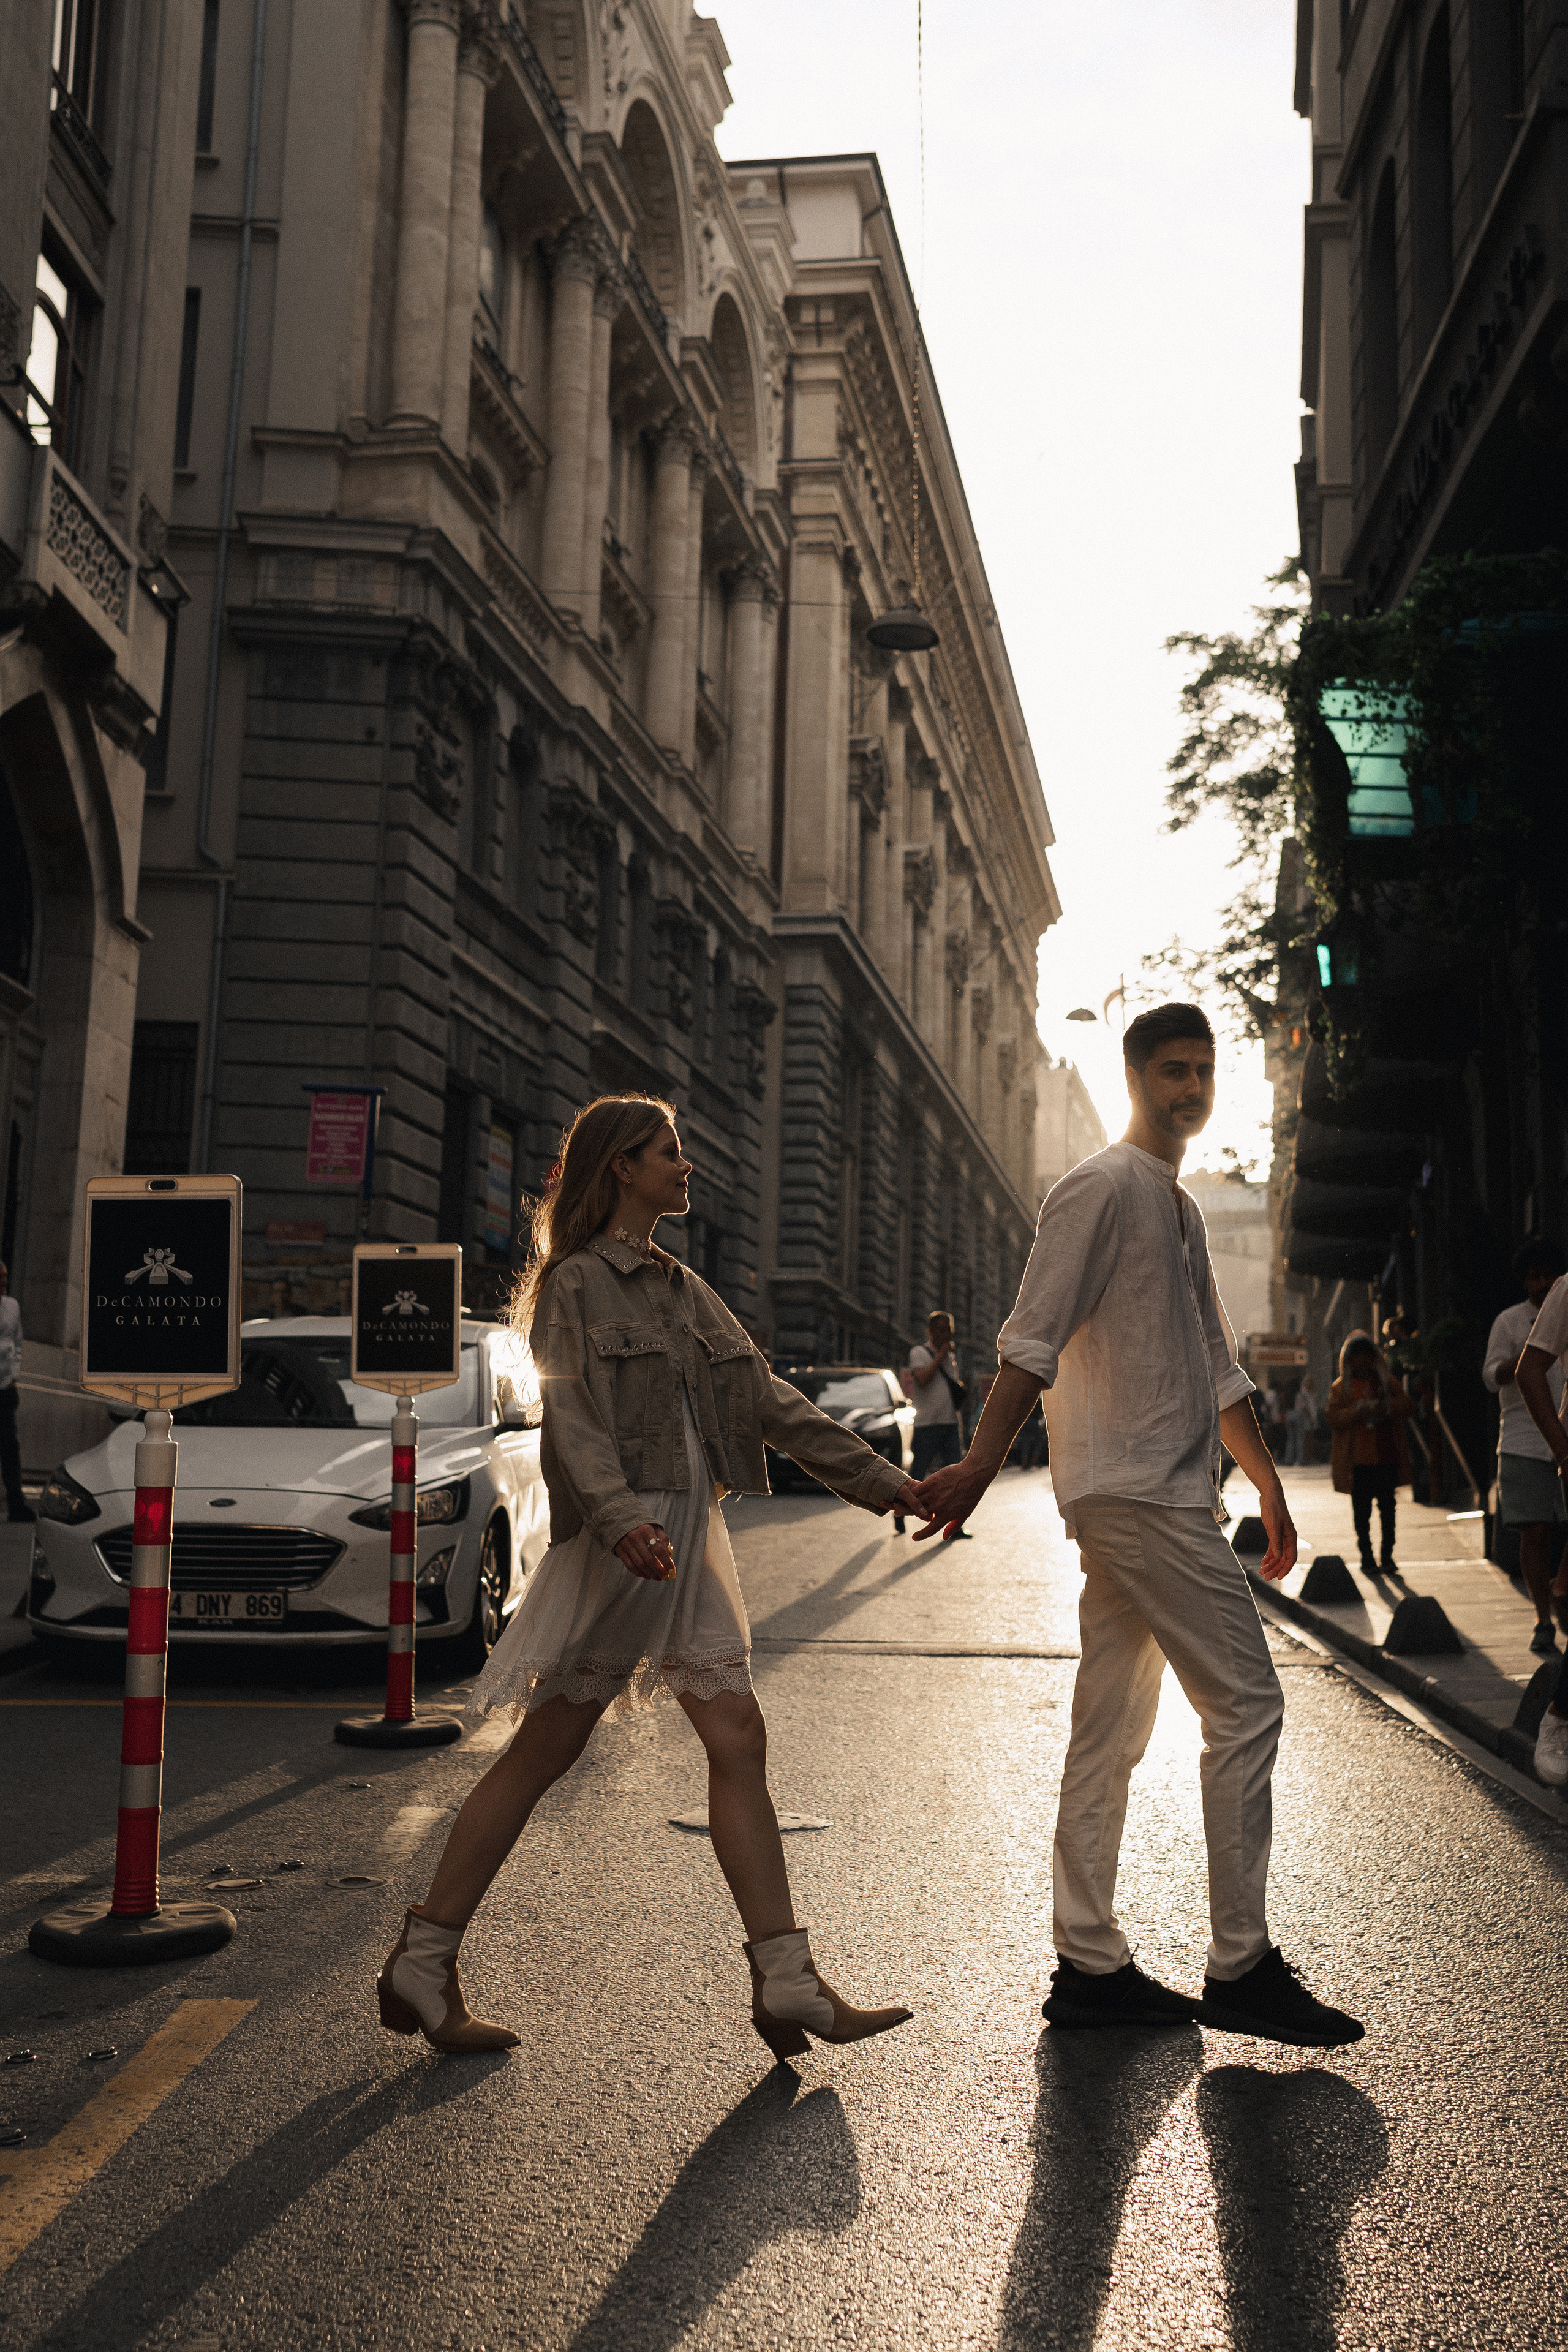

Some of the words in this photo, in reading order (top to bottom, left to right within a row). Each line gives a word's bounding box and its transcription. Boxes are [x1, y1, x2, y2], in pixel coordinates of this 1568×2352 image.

[97, 1295, 222, 1308] DeCAMONDO
[116, 1316, 200, 1325] GALATA
[363, 1321, 450, 1330] DeCAMONDO
[171, 1594, 182, 1615] 4
[197, 1594, 232, 1616] DNY
[246, 1594, 282, 1616] 869
